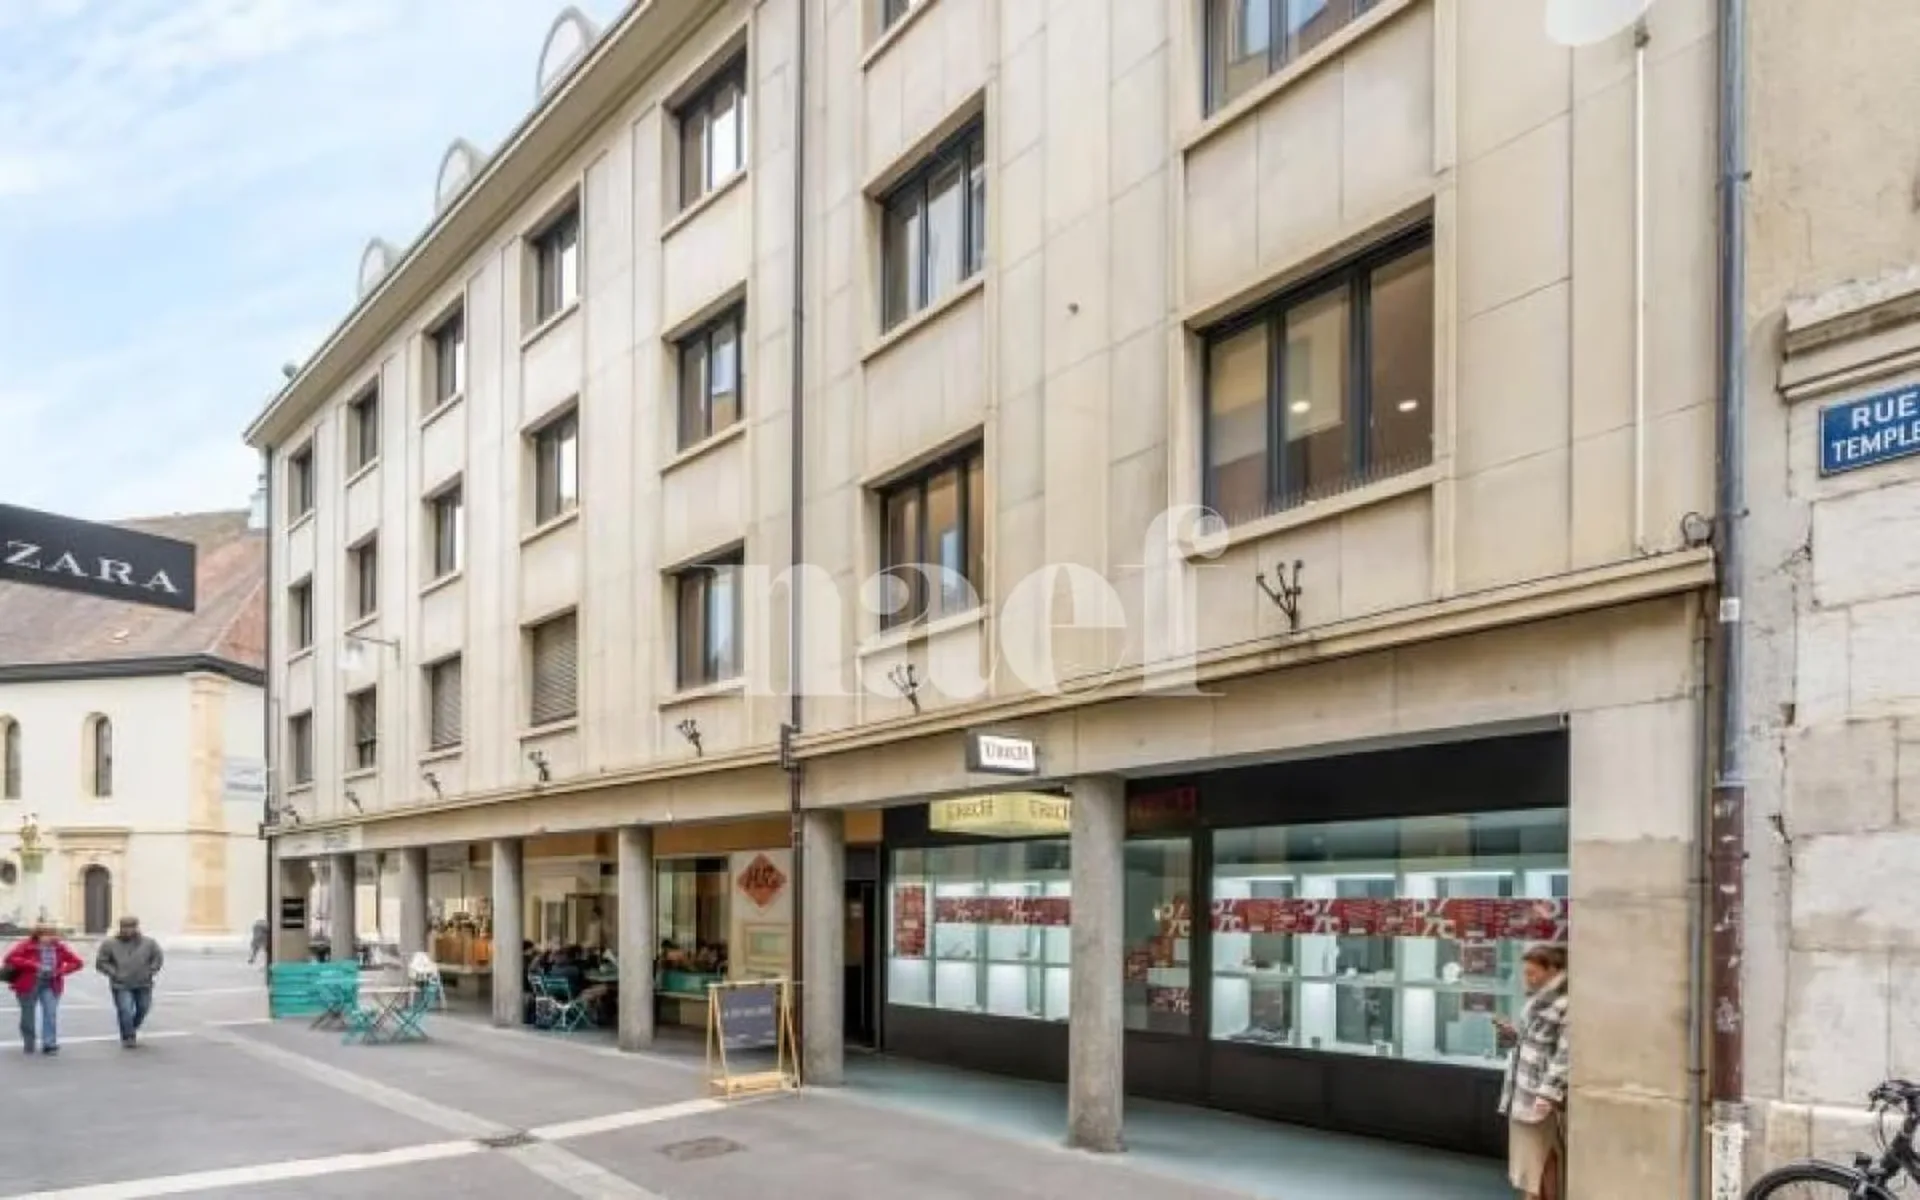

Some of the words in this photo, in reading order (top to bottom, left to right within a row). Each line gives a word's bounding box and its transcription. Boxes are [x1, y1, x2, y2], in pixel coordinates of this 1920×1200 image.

[1851, 391, 1918, 431] RUE
[1831, 419, 1920, 463] TEMPLE
[5, 539, 183, 594] ZARA
